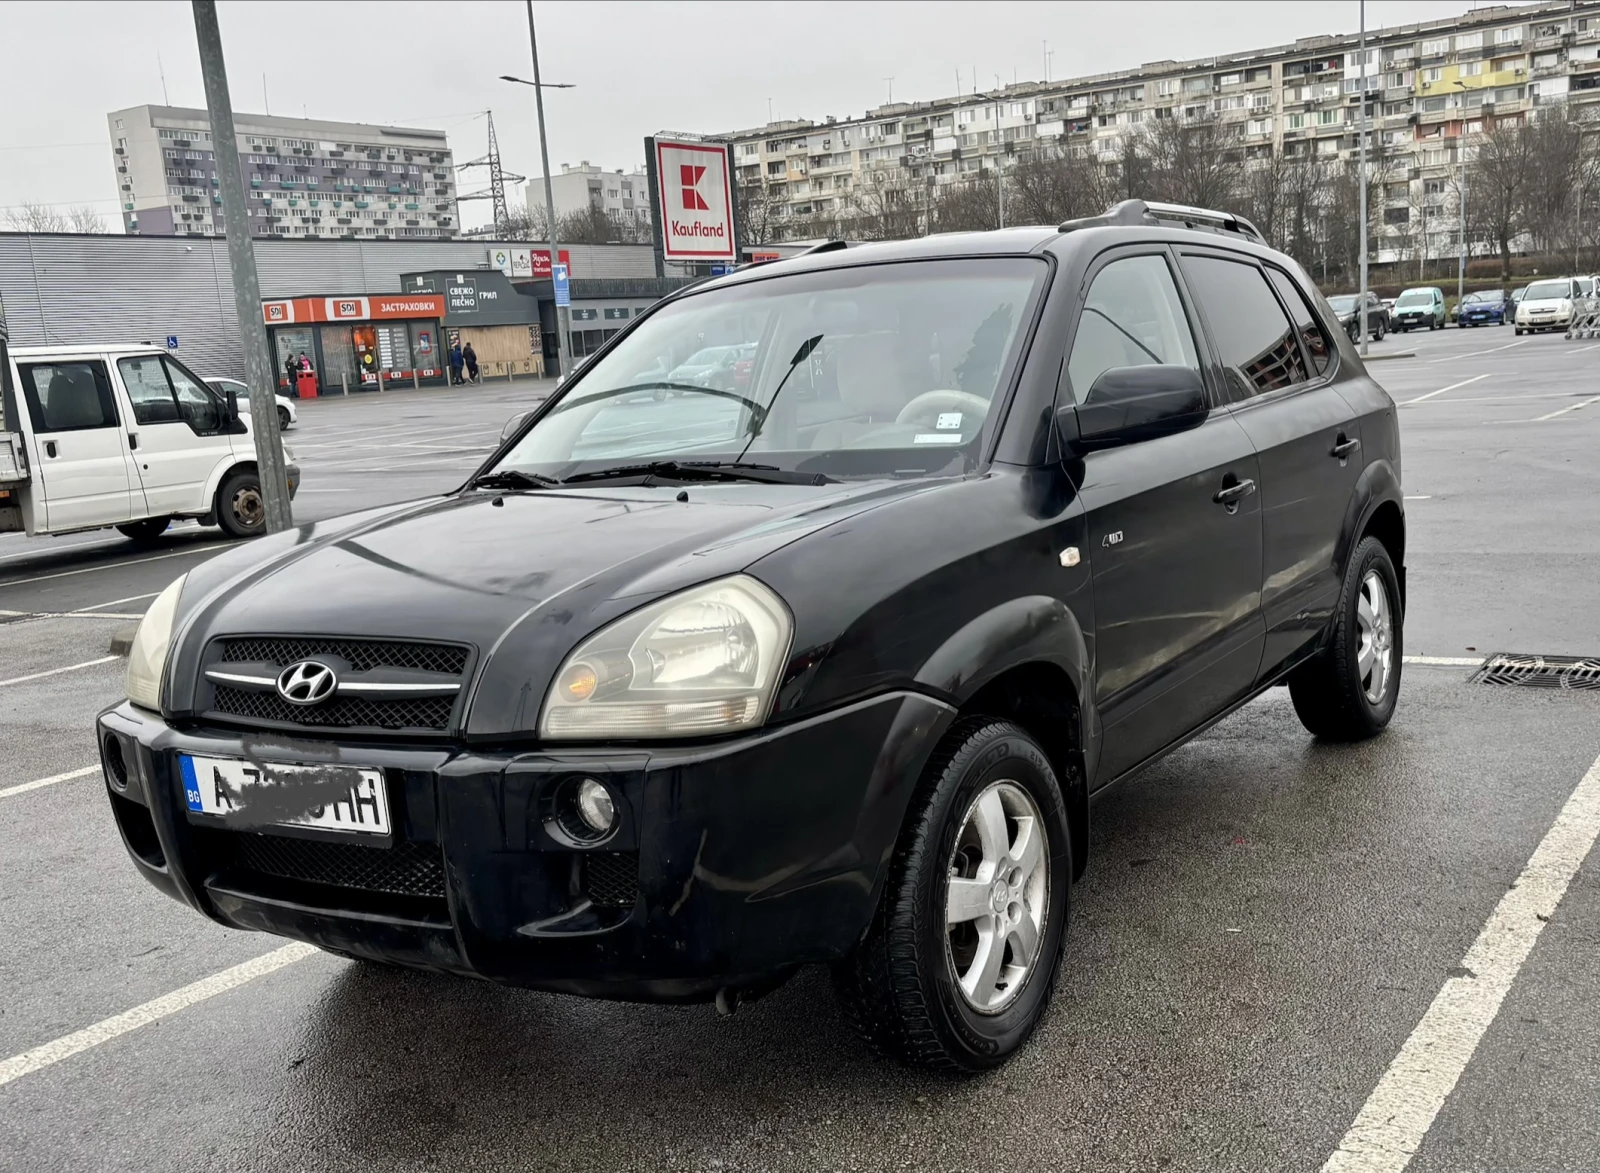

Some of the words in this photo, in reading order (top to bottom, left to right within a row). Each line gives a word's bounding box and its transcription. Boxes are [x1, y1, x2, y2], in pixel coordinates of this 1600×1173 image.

[672, 220, 724, 238] Kaufland
[449, 287, 474, 296] СВЕЖО
[479, 291, 498, 300] ГРИЛ
[381, 301, 435, 312] ЗАСТРАХОВКИ
[451, 298, 475, 307] ЛЕСНО
[270, 306, 282, 316] SDI
[341, 303, 355, 312] SDI
[187, 789, 200, 803] BG
